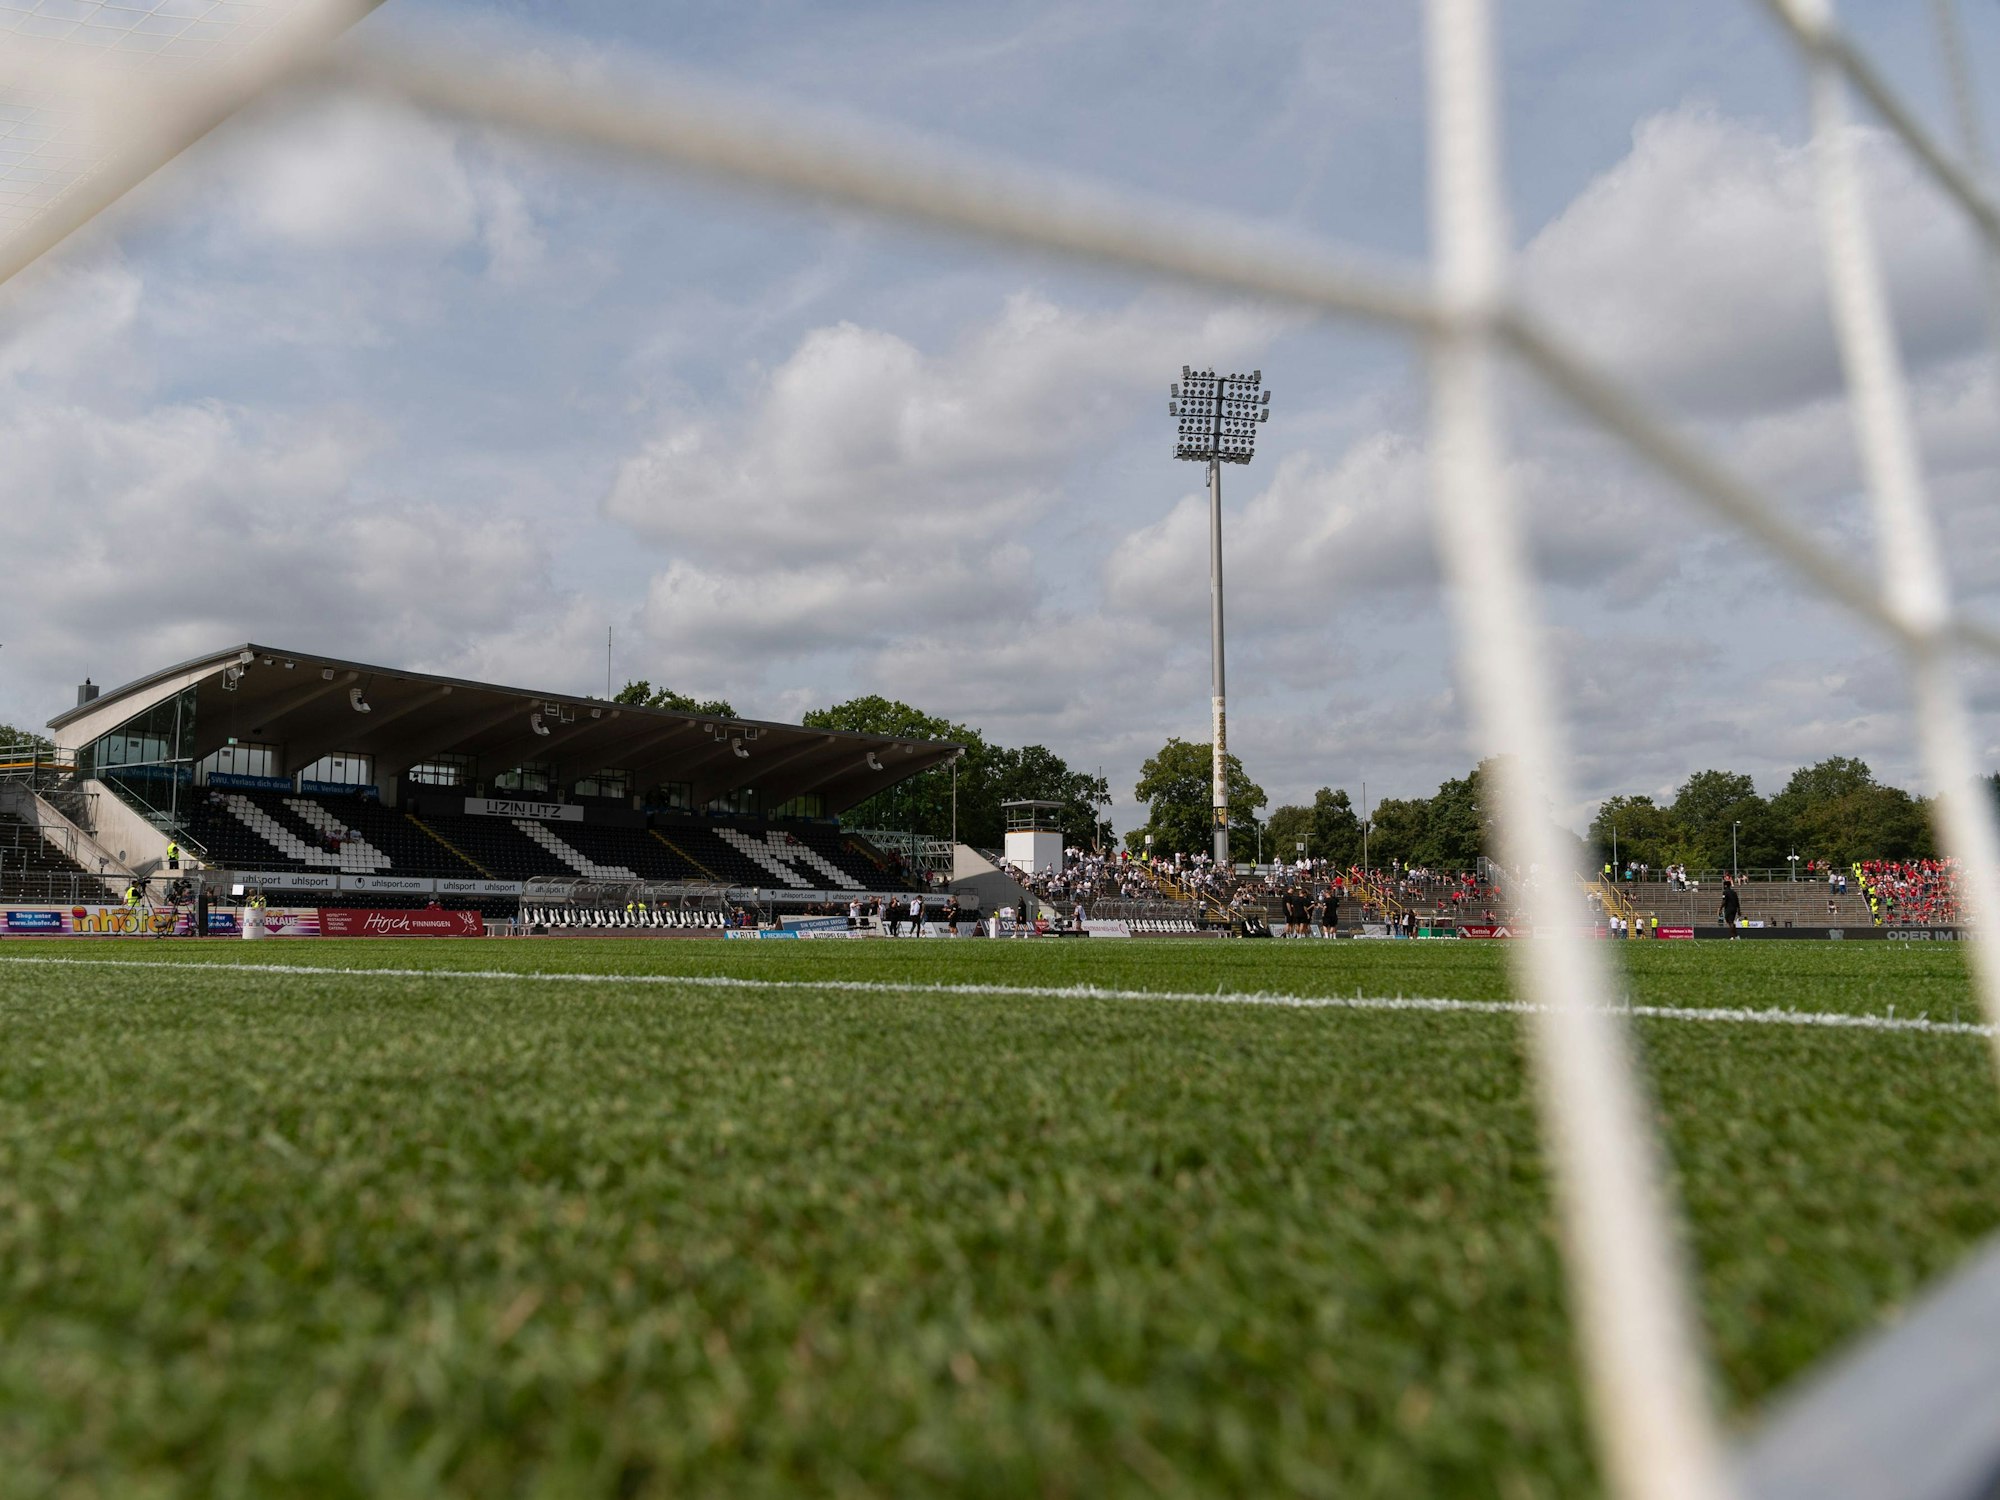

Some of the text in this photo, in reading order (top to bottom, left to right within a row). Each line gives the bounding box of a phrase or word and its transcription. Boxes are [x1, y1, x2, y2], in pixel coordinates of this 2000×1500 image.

[211, 776, 229, 785] SWU.
[231, 778, 255, 786] Verlass
[257, 780, 271, 788] dich
[321, 785, 344, 793] Verlass
[486, 800, 561, 818] UZIN UTZ
[291, 876, 328, 887] uhlsport
[371, 879, 421, 889] uhlsport.com
[443, 881, 476, 892] uhlsport
[484, 882, 516, 893] uhlsport
[781, 891, 817, 900] uhlsport.com
[832, 893, 856, 902] uhlsport
[15, 912, 32, 920] Shop
[71, 905, 179, 933] inhofer
[264, 916, 299, 926] RKAUF
[363, 912, 411, 934] Hirsch
[412, 920, 451, 928] FINNINGEN
[1886, 930, 1931, 941] ODER
[1934, 930, 1954, 941] IM
